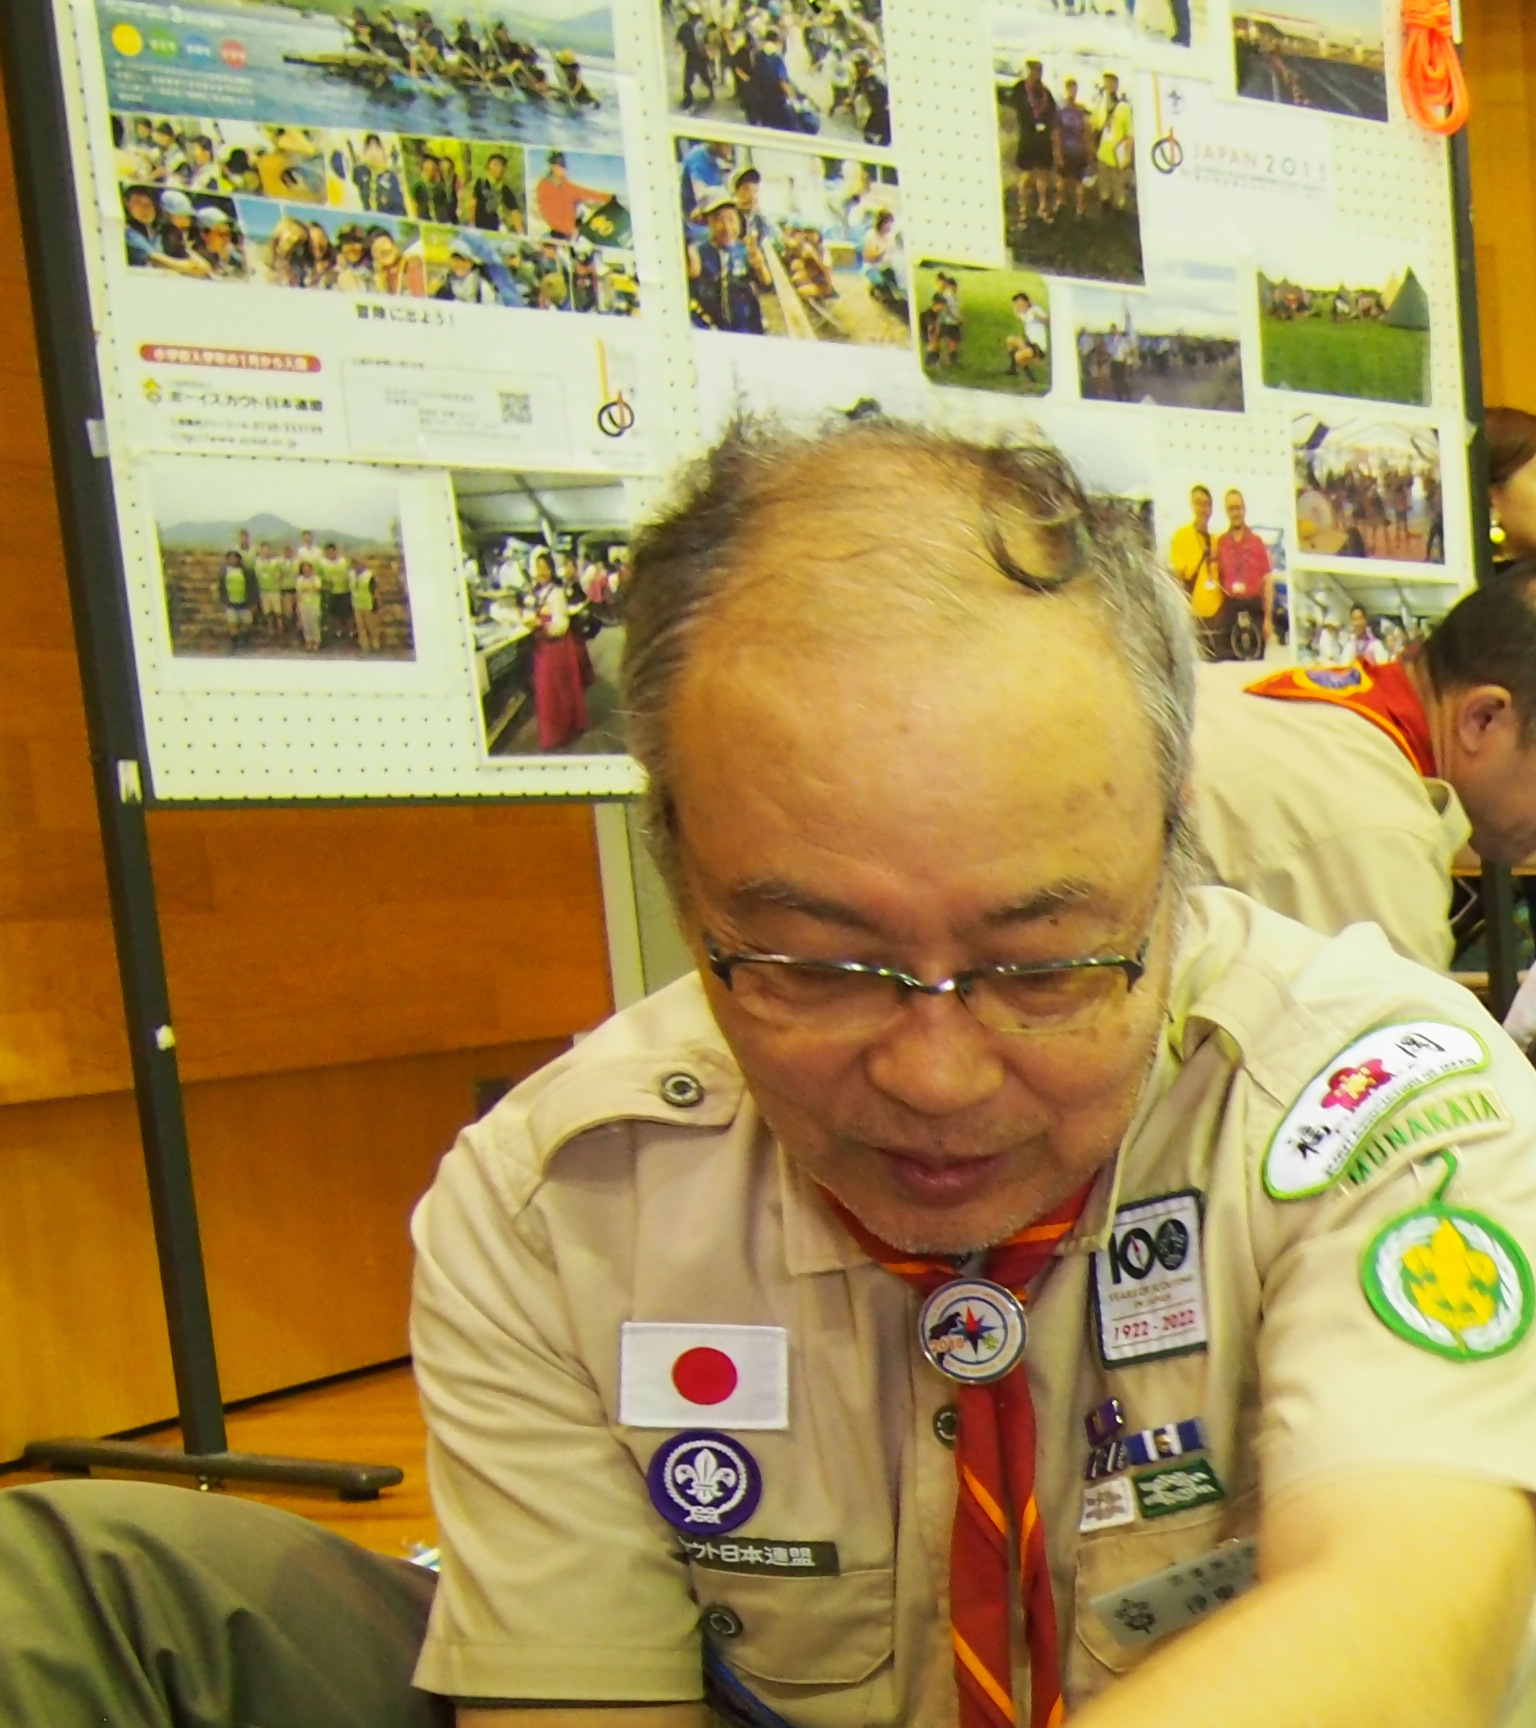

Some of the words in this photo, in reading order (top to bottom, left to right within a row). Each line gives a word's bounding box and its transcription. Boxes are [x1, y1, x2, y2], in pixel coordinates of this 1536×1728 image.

[1346, 1090, 1502, 1186] MUNAKATA
[1107, 1218, 1189, 1284] 100
[1114, 1320, 1150, 1341] 1922
